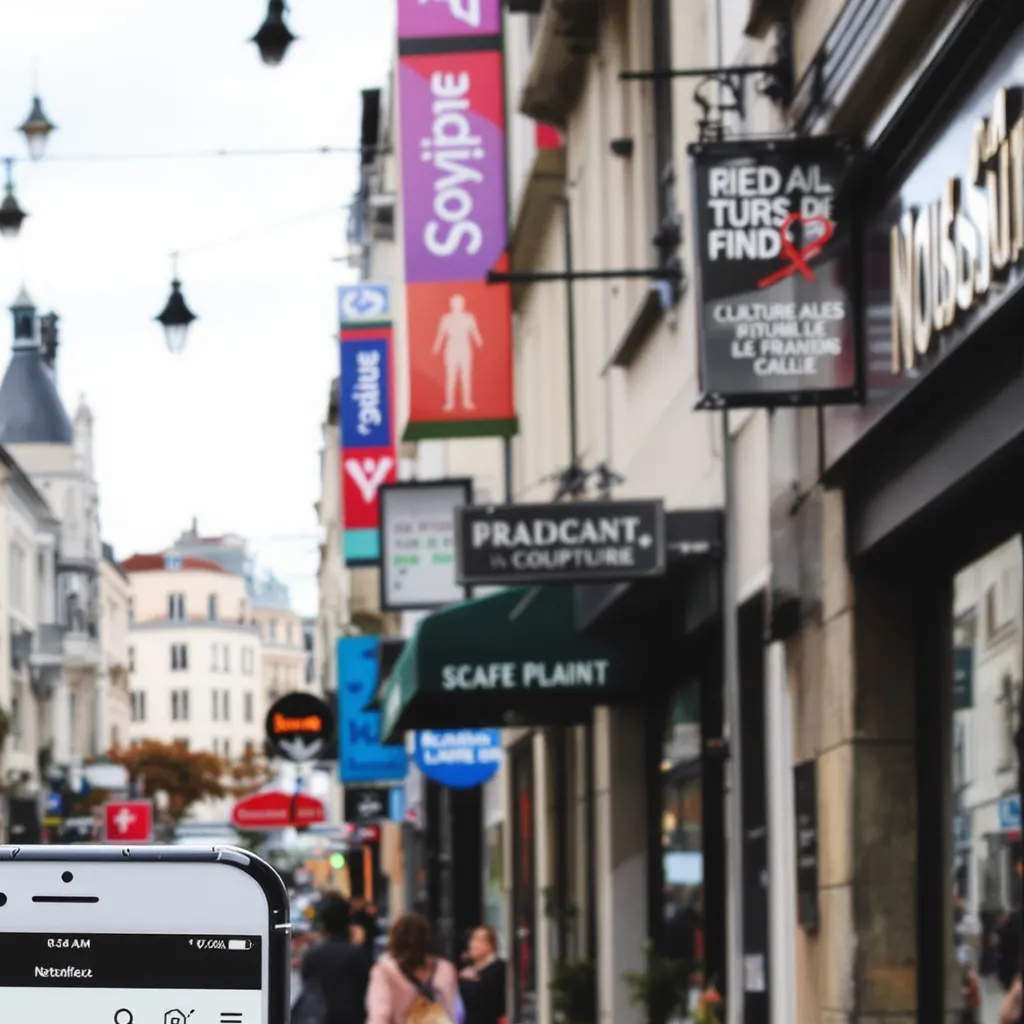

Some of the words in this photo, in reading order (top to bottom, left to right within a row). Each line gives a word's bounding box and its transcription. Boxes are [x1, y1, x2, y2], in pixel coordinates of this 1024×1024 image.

[708, 165, 782, 199] RIED
[441, 663, 517, 691] SCAFE
[71, 938, 91, 949] AM
